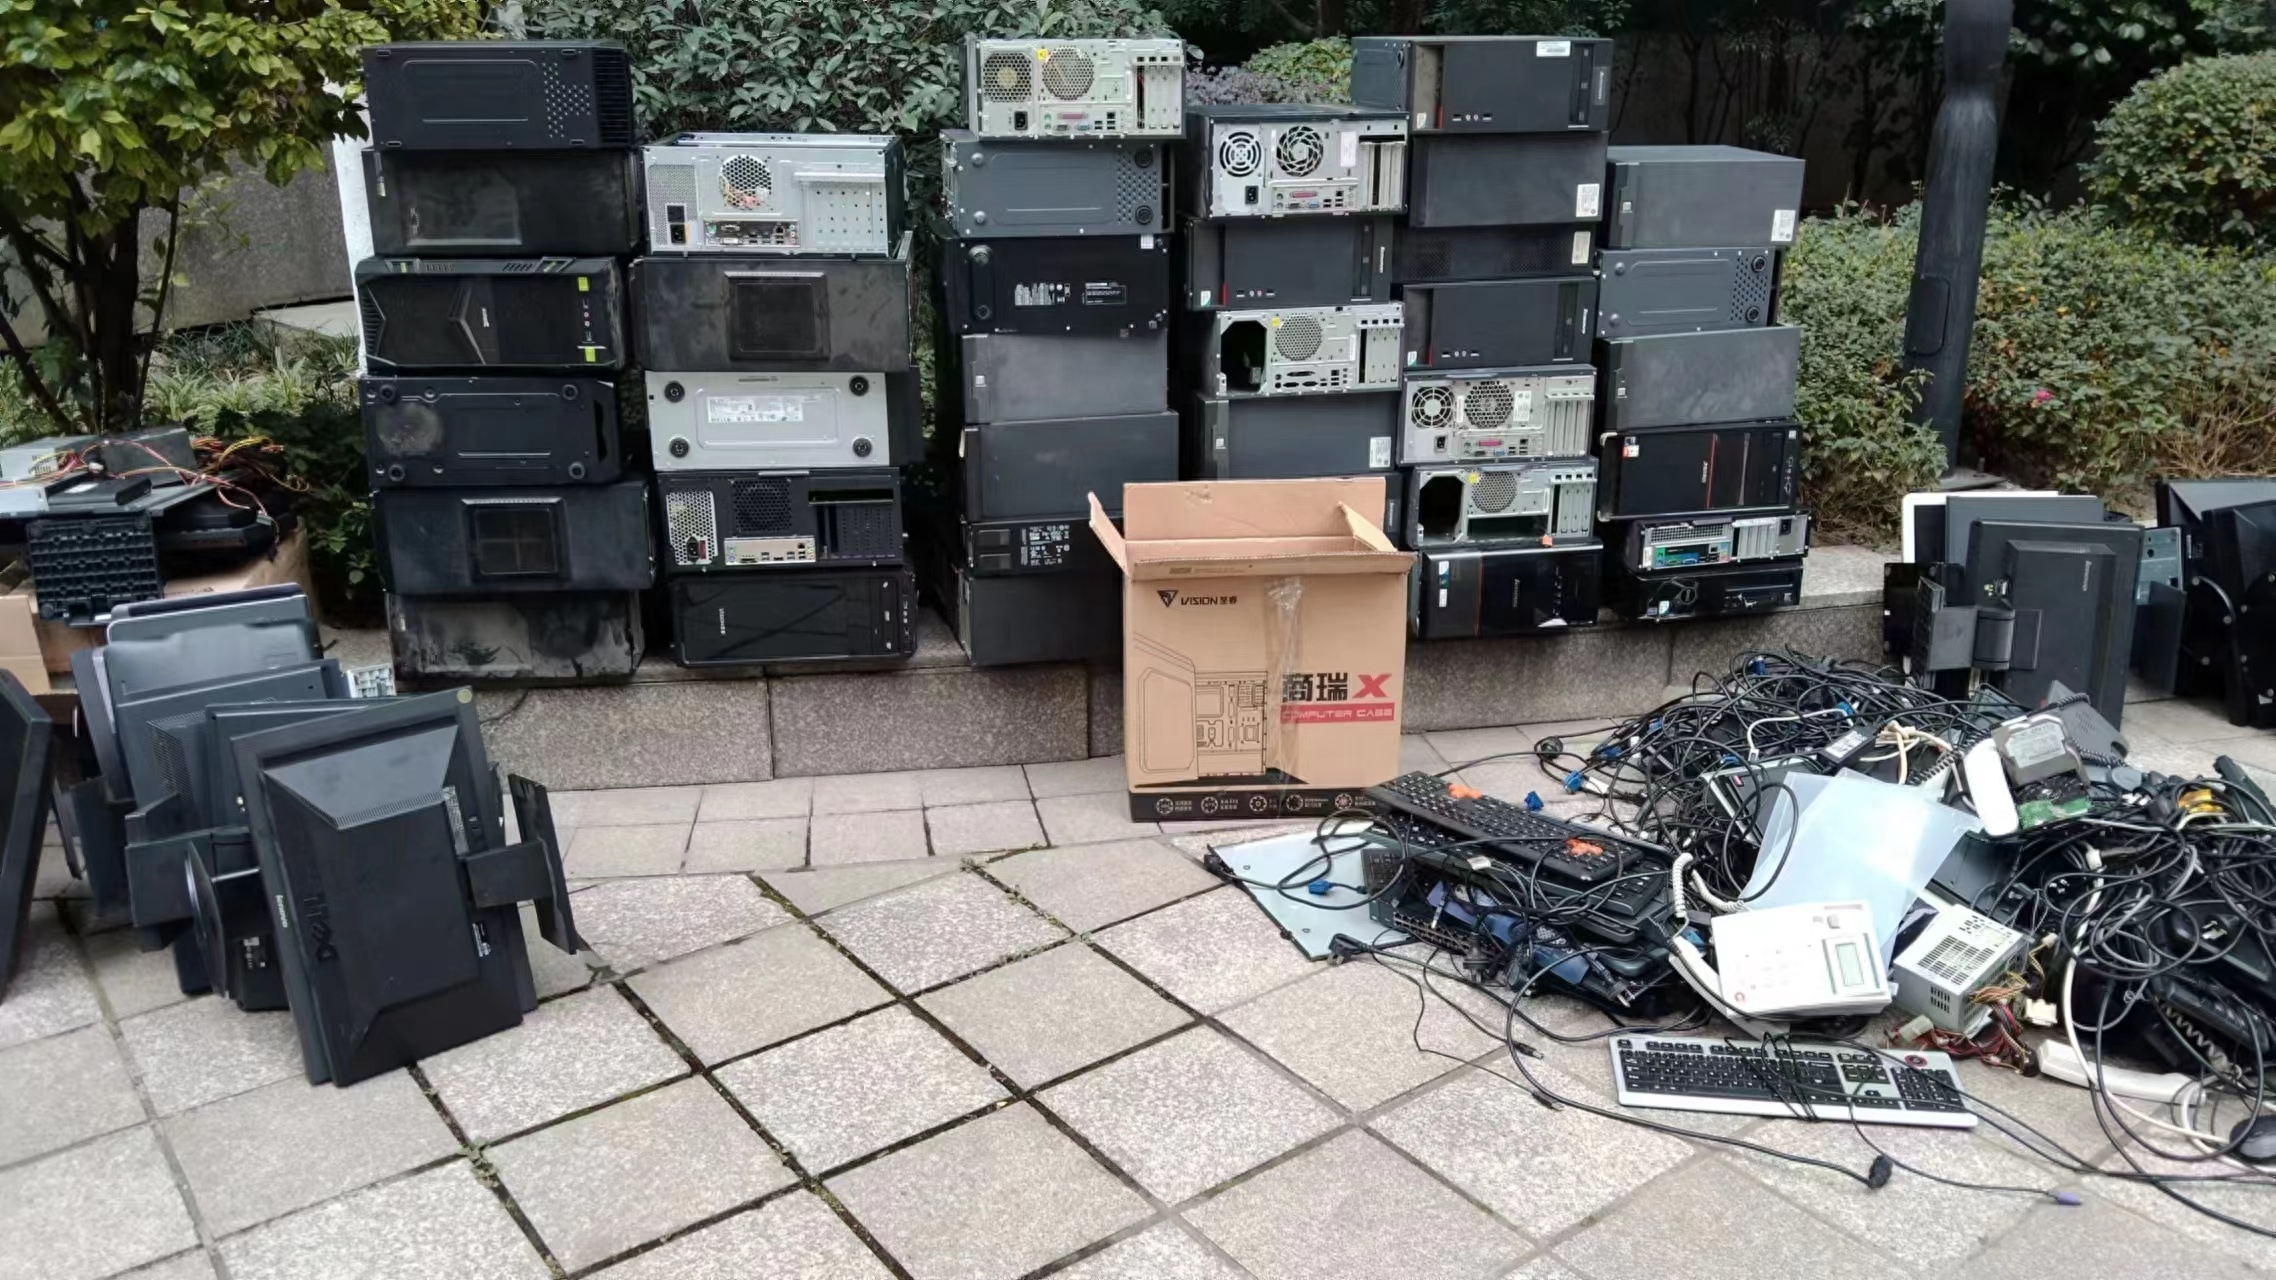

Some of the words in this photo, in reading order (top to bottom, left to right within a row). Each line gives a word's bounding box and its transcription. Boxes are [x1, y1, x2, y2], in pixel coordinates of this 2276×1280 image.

[1180, 596, 1218, 606] VISION
[1351, 673, 1392, 699] X
[1282, 709, 1353, 719] COMPUTER
[1356, 708, 1393, 717] CASE
[275, 894, 288, 928] lenovo
